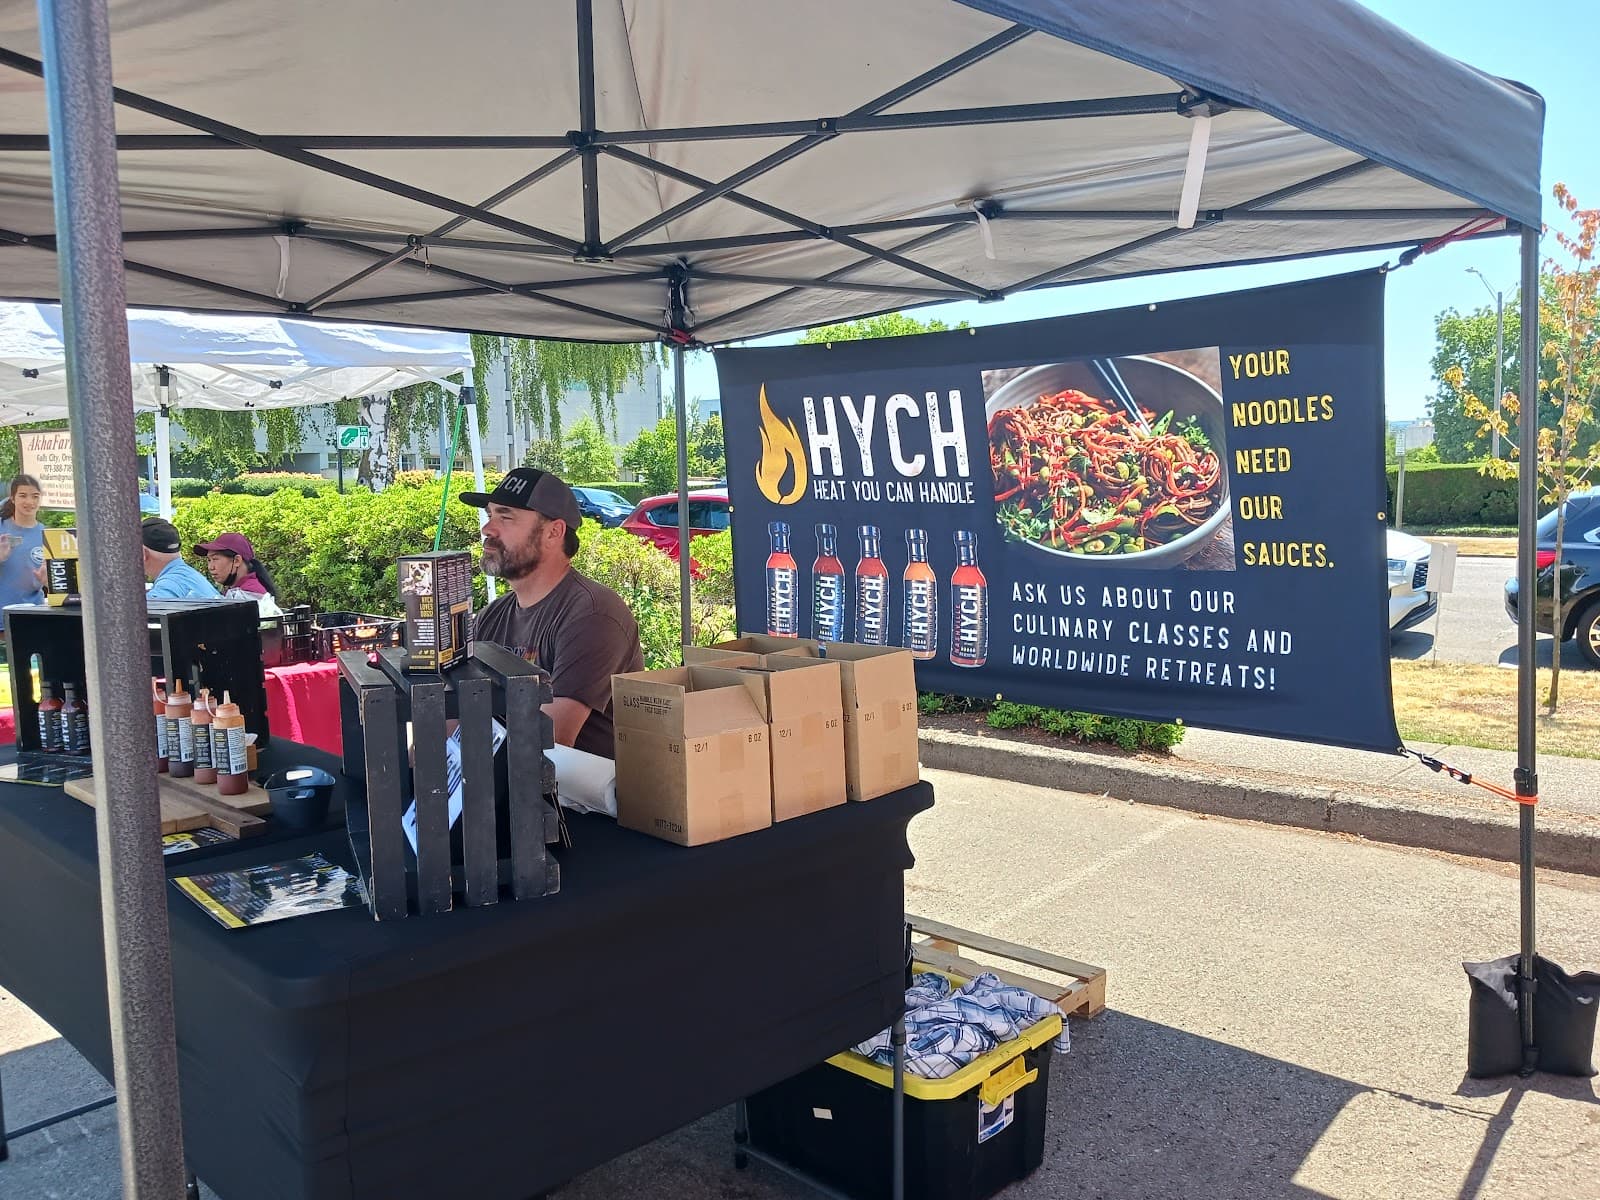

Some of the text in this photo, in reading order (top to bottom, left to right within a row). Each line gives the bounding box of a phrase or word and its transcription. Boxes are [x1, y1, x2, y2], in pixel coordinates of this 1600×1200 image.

[1229, 350, 1290, 380] YOUR
[1232, 395, 1335, 427] NOODLES
[803, 390, 970, 477] HYCH
[1235, 447, 1291, 474] NEED
[813, 480, 975, 504] HEAT YOU CAN HANDLE
[1239, 496, 1283, 520] OUR
[1243, 542, 1335, 568] SAUCES.
[52, 561, 68, 591] HYCH
[775, 569, 791, 618] HYCH
[819, 575, 836, 624] HYCH
[864, 578, 881, 629] HYCH
[912, 581, 928, 634] HYCH
[1012, 582, 1235, 614] ASK US ABOUT OUR
[959, 586, 978, 642] HYCH
[1013, 614, 1292, 655] CULINARY CLASSES AND
[1012, 645, 1276, 691] WORLDWIDE RETREATS!
[624, 696, 640, 708] GLASS
[694, 742, 708, 752] 12/1
[754, 733, 762, 742] OZ
